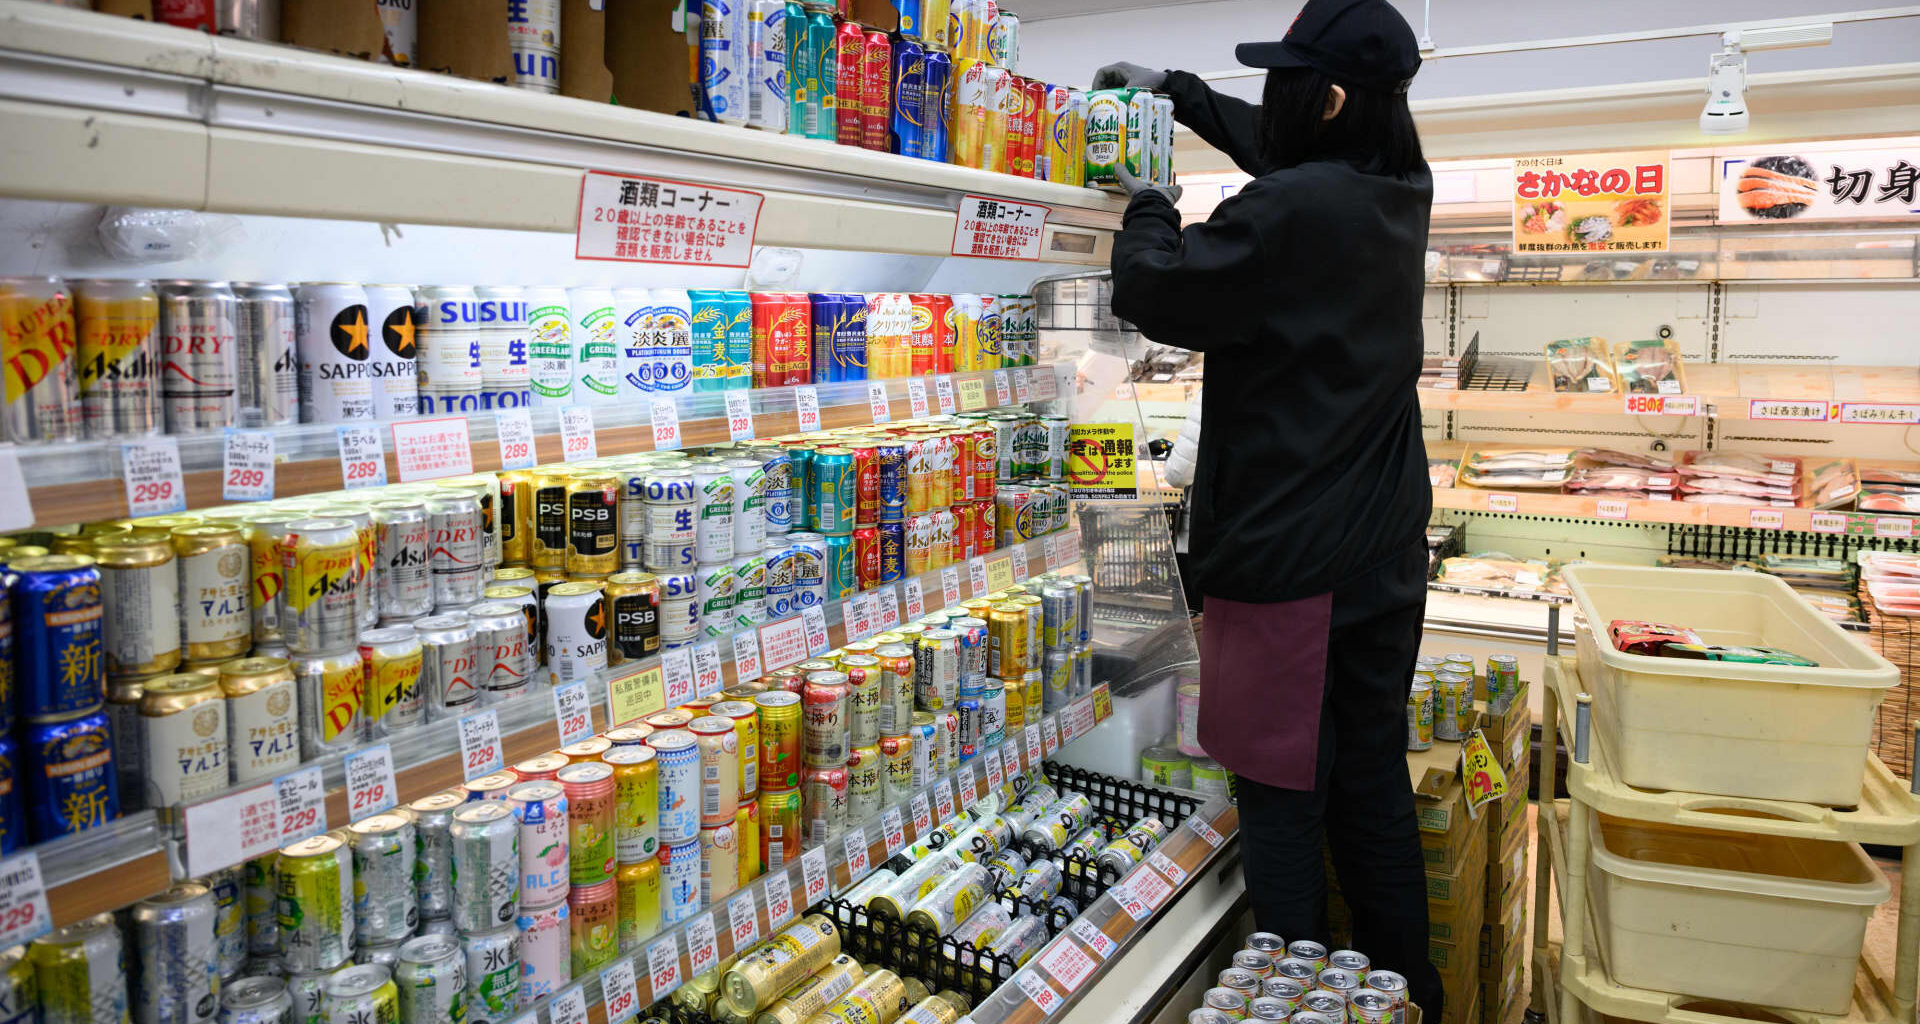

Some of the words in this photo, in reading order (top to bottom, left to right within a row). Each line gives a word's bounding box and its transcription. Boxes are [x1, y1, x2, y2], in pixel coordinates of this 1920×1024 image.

[1516, 158, 1563, 167] 7の付く日は
[1517, 165, 1663, 198] さかなの日
[1825, 162, 1920, 204] 切身
[619, 180, 730, 211] 酒類コーナー
[594, 207, 746, 234] 20歳以上の年齢であることを
[976, 201, 1032, 221] 酒類コーナー
[616, 226, 725, 248] 確認できない場合には
[615, 242, 713, 261] 酒類を販売しません
[712, 321, 727, 362] 金麦
[792, 320, 808, 358] 金麦
[509, 339, 526, 365] 生
[801, 413, 816, 424] 239
[1760, 406, 1820, 417] さば西京漬け
[656, 427, 675, 441] 239
[732, 419, 749, 432] 239
[504, 443, 528, 460] 289
[567, 437, 589, 452] 239
[347, 462, 377, 480] 289
[1106, 459, 1133, 468] します
[227, 469, 264, 487] 289
[133, 481, 172, 503] 299
[572, 509, 609, 521] PSB
[675, 509, 692, 531] 生
[884, 540, 899, 573] 金麦
[618, 611, 655, 624] PSB
[855, 620, 869, 633] 189
[883, 611, 896, 623] 189
[810, 633, 825, 648] 189
[60, 640, 100, 687] 新
[738, 659, 756, 674] 189
[700, 671, 717, 688] 219
[669, 681, 688, 698] 219
[563, 714, 586, 736] 229
[468, 746, 494, 769] 229
[353, 785, 384, 809] 219
[963, 789, 974, 803] 139
[63, 785, 108, 832] 新
[939, 802, 951, 817] 149
[282, 808, 316, 834] 229
[916, 816, 928, 831] 149
[888, 832, 901, 848] 149
[851, 855, 865, 872] 149
[808, 878, 824, 896] 139
[771, 900, 788, 919] 139
[735, 921, 753, 941] 139
[484, 949, 505, 971] 氷
[693, 945, 712, 967] 139
[654, 967, 675, 989] 139
[609, 993, 632, 1016] 139
